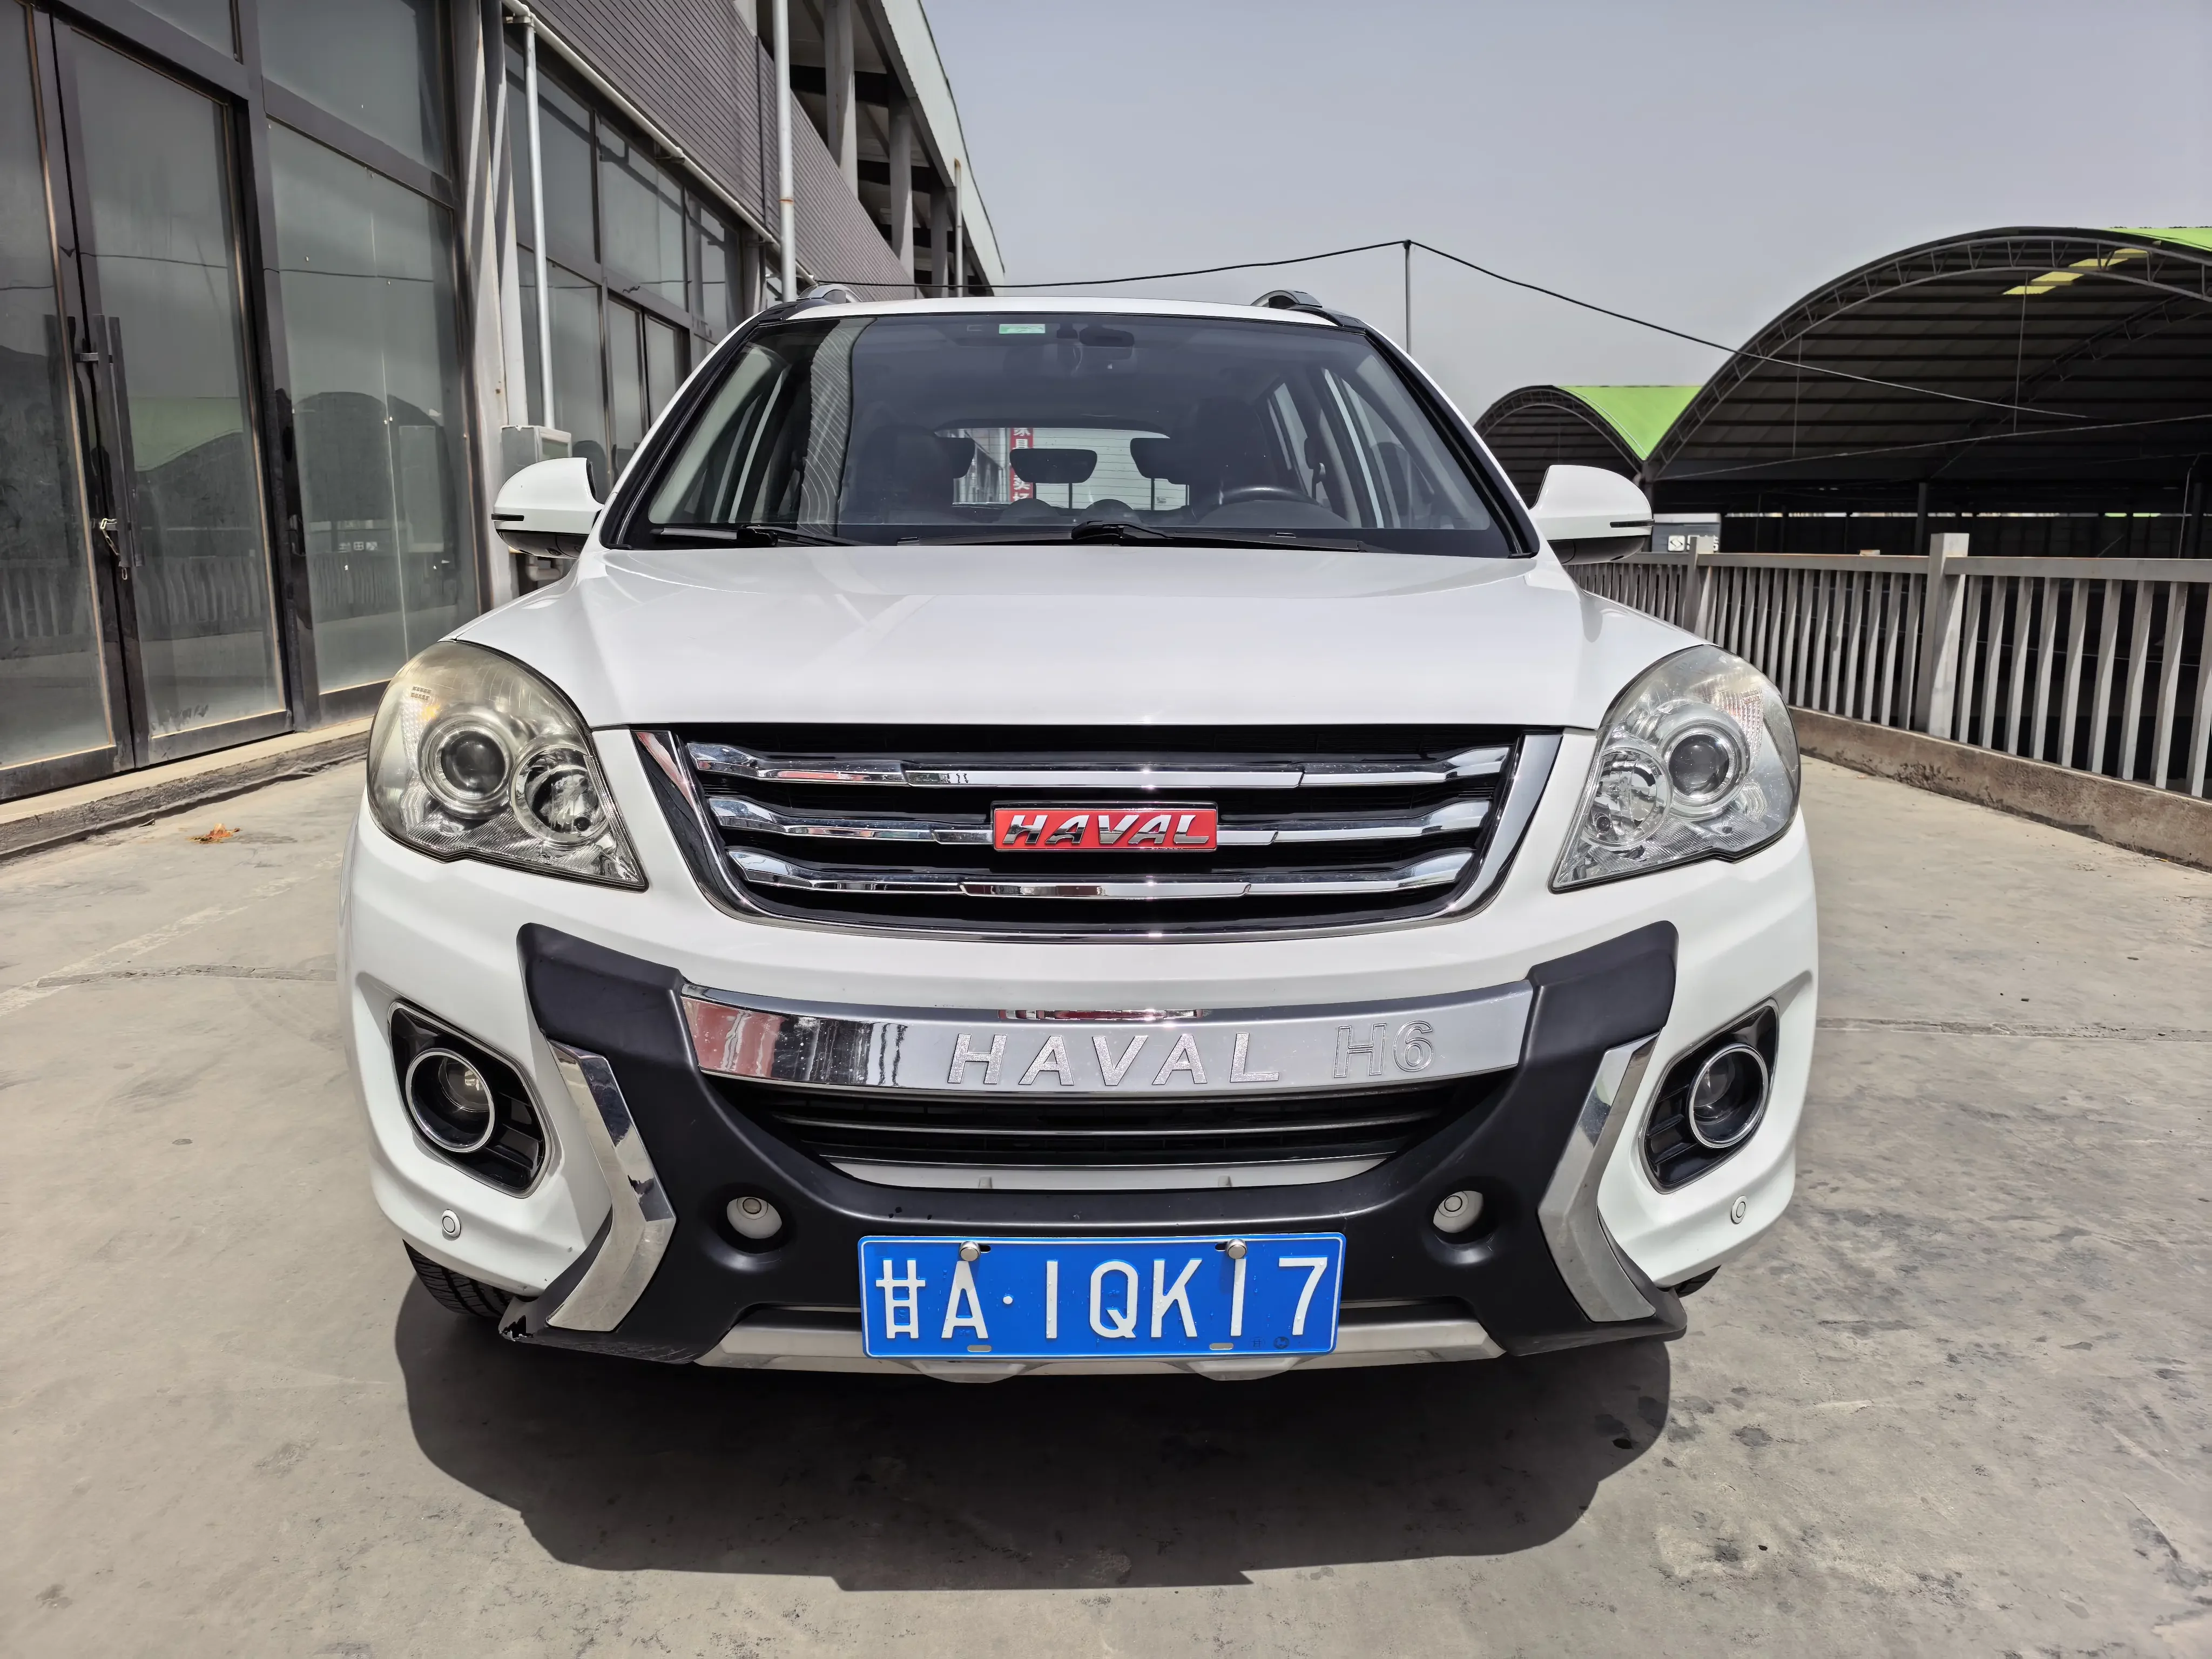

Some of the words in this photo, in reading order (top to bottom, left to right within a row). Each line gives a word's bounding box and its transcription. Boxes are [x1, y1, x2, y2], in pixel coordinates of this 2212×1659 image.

[1002, 814, 1210, 845] HAVAL
[948, 1032, 1279, 1086] HAVAL
[1333, 1020, 1434, 1078] H6
